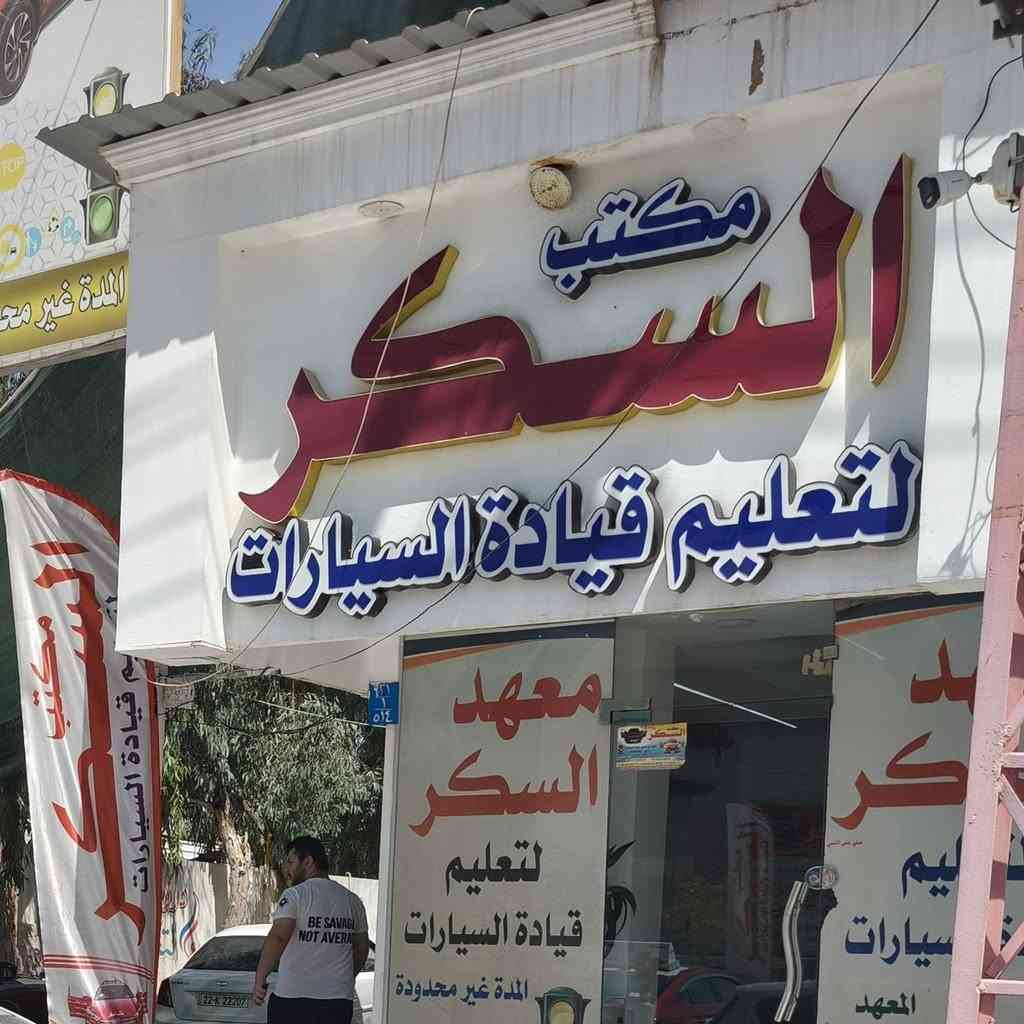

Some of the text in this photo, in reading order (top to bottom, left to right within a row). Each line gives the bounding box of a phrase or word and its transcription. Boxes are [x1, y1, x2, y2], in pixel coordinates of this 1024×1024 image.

[542, 178, 768, 298] مكتب
[35, 279, 75, 334] غير
[78, 265, 126, 313] المدة
[238, 153, 913, 523] السكر
[228, 440, 919, 617] لتعليم قيادة السيارات
[29, 614, 71, 741] مكتب
[453, 667, 602, 740] معهد
[30, 541, 145, 947] السكر
[115, 692, 143, 765] قيادة
[408, 744, 599, 837] السكر
[124, 773, 151, 893] السيارات
[445, 839, 543, 896] لتعليم
[298, 929, 320, 943] NOT
[308, 916, 322, 929] BE
[404, 909, 584, 957] قيادة السيارات
[845, 916, 953, 967] سيارات
[396, 974, 529, 1006] المدة غير محدودة
[856, 991, 916, 1020] المعهد
